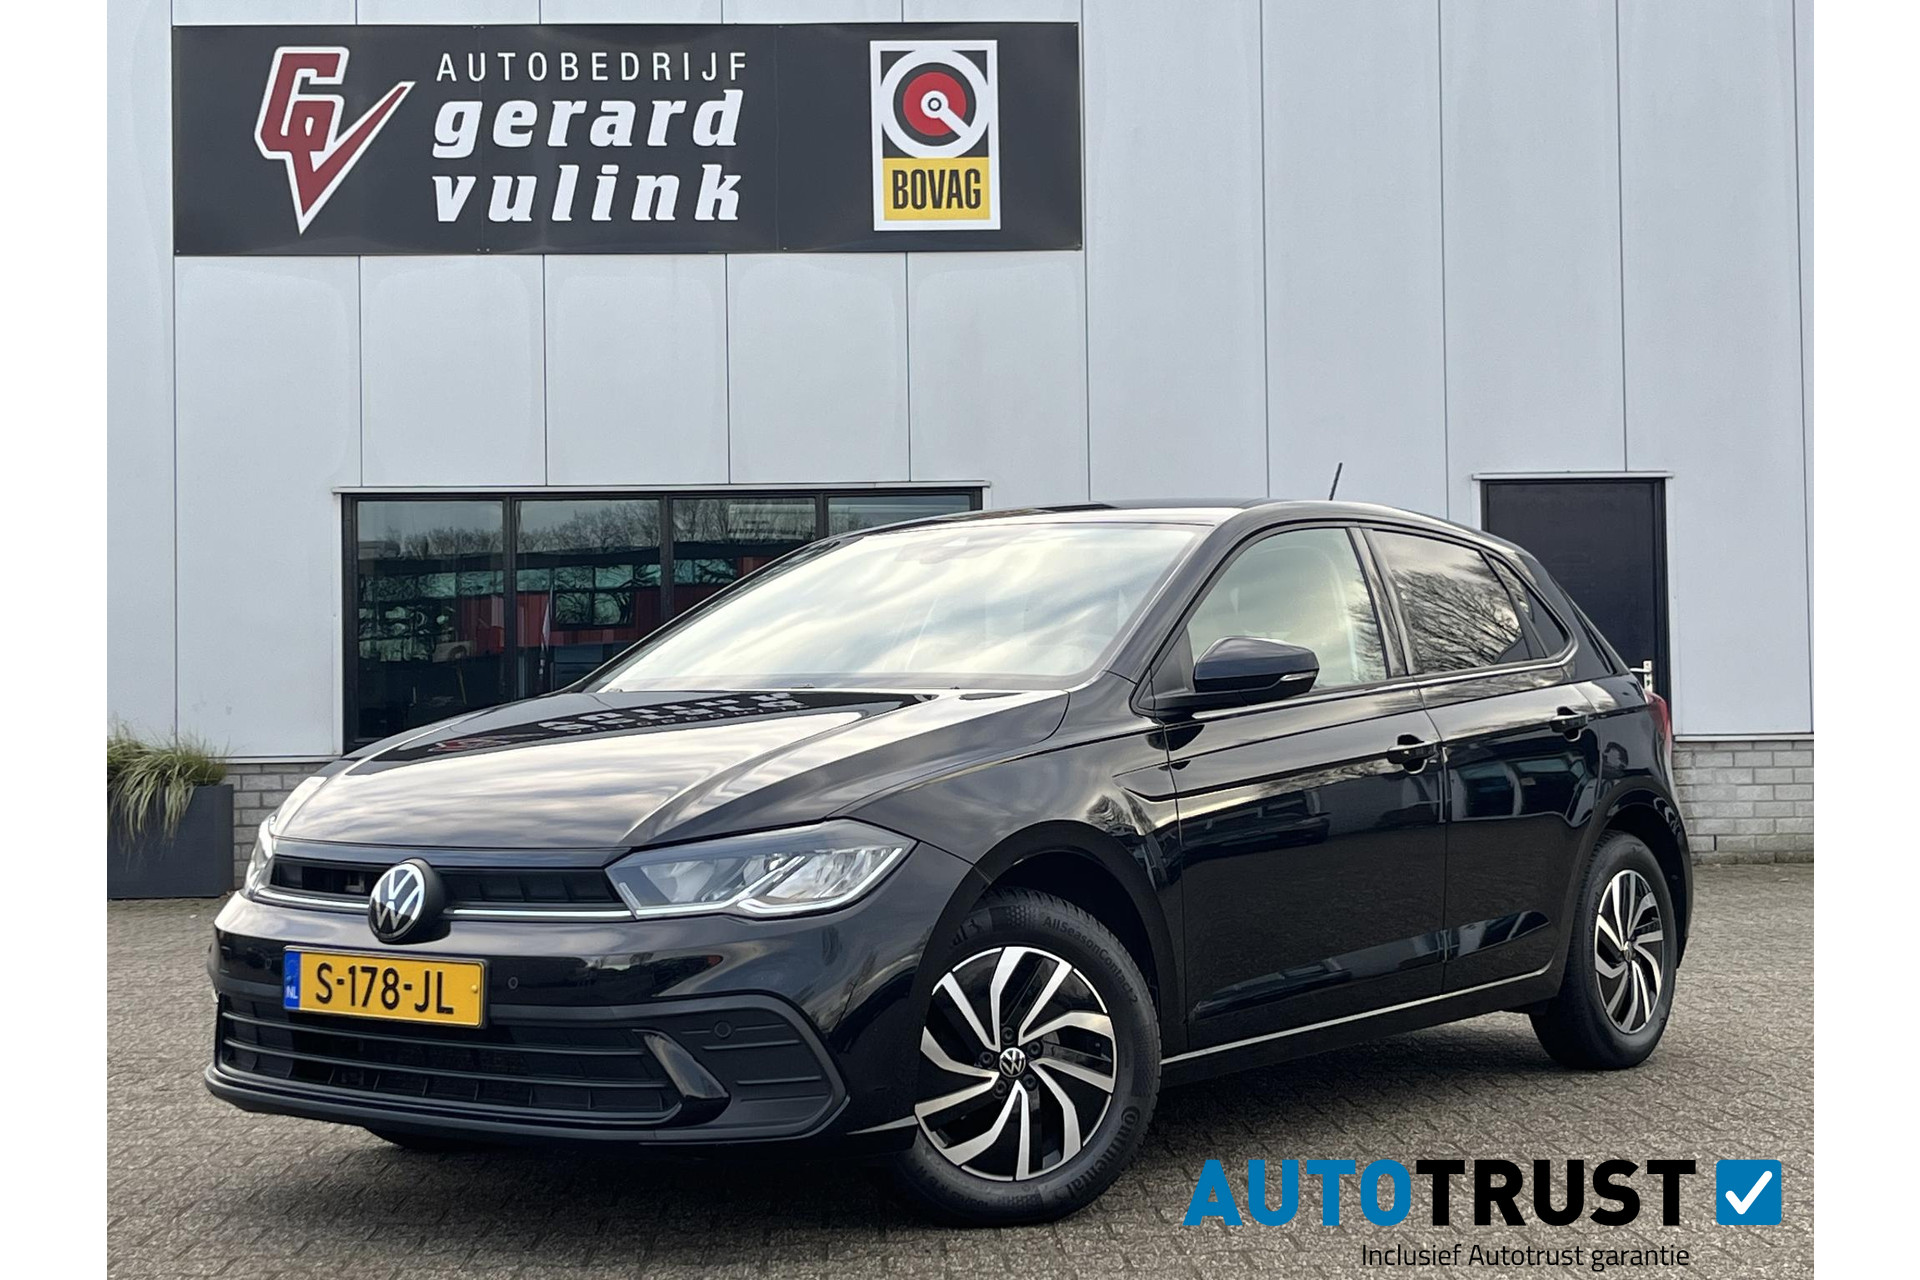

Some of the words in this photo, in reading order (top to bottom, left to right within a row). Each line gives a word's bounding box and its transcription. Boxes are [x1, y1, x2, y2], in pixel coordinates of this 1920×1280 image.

[437, 53, 748, 82] AUTOBEDRIJF
[432, 90, 743, 158] gerard
[432, 165, 740, 222] vulink
[892, 169, 982, 210] BOVAG
[285, 986, 299, 1000] NL
[315, 962, 455, 1015] S-178-JL
